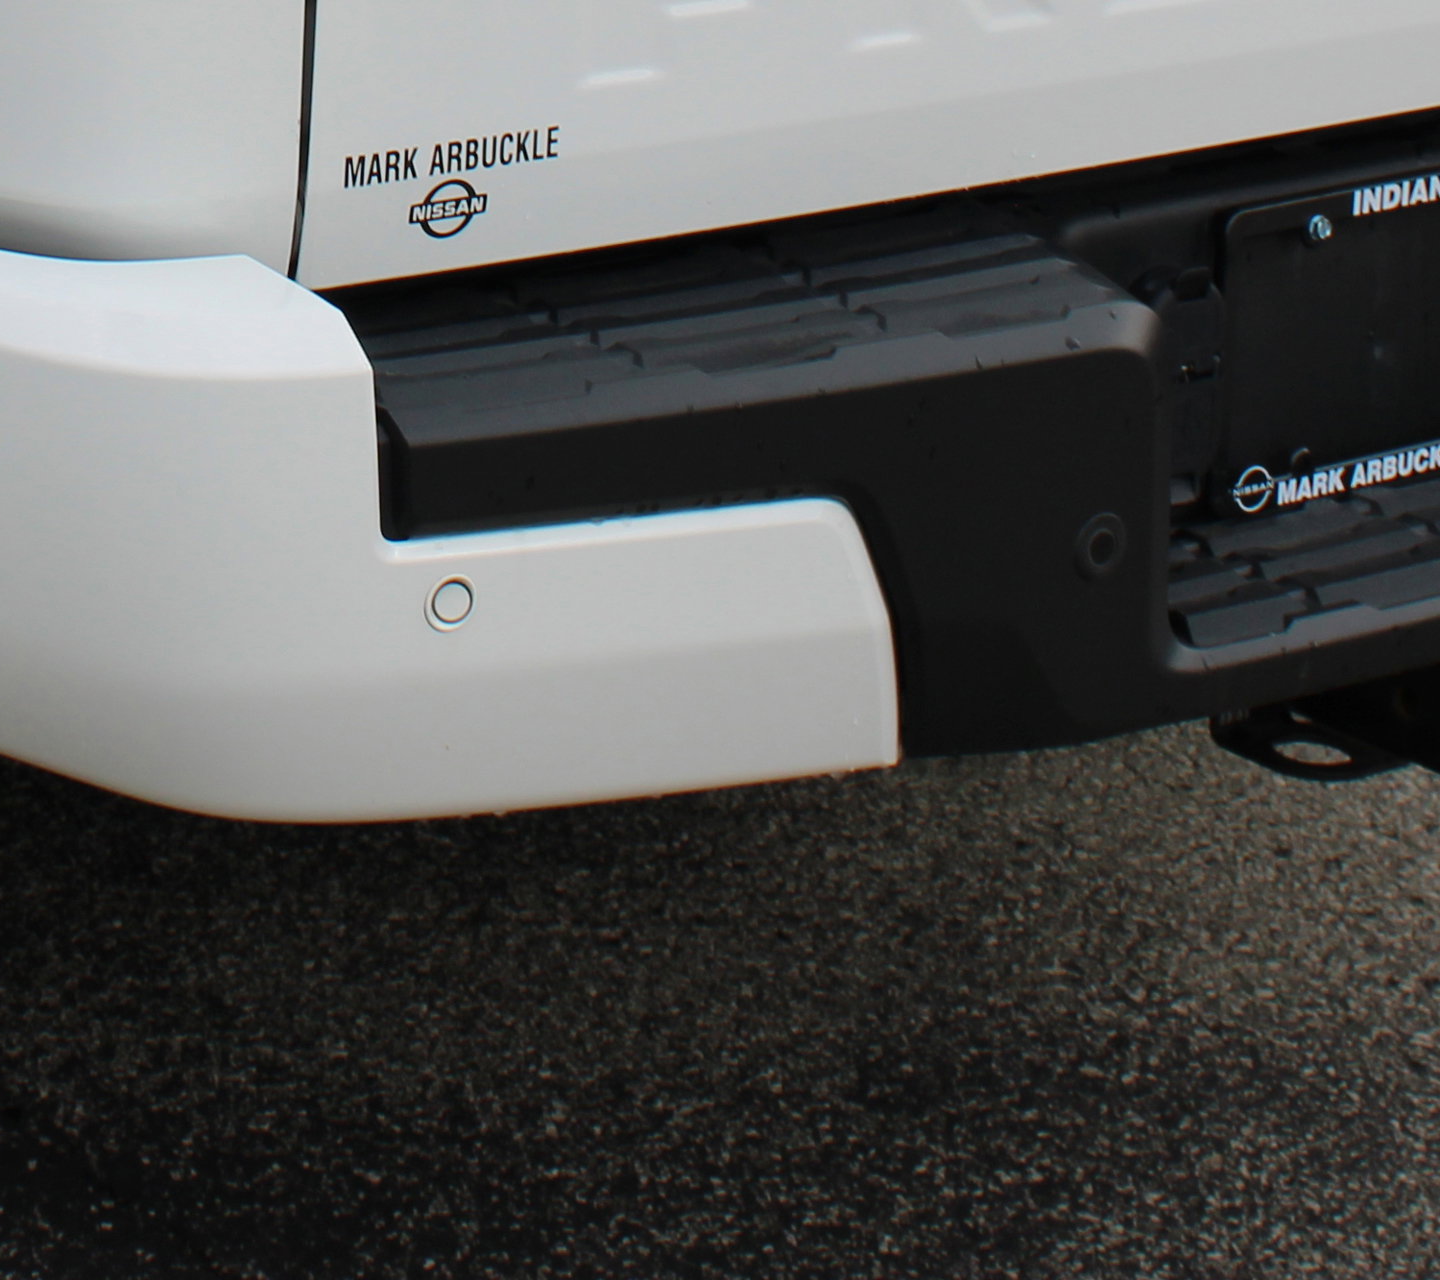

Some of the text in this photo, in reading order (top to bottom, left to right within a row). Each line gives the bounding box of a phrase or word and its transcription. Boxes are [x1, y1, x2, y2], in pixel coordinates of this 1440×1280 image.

[343, 125, 560, 189] MARK ARBUCKLE
[412, 196, 485, 222] NISSAN
[1232, 477, 1274, 498] NISSAN
[1276, 467, 1345, 506] MARK
